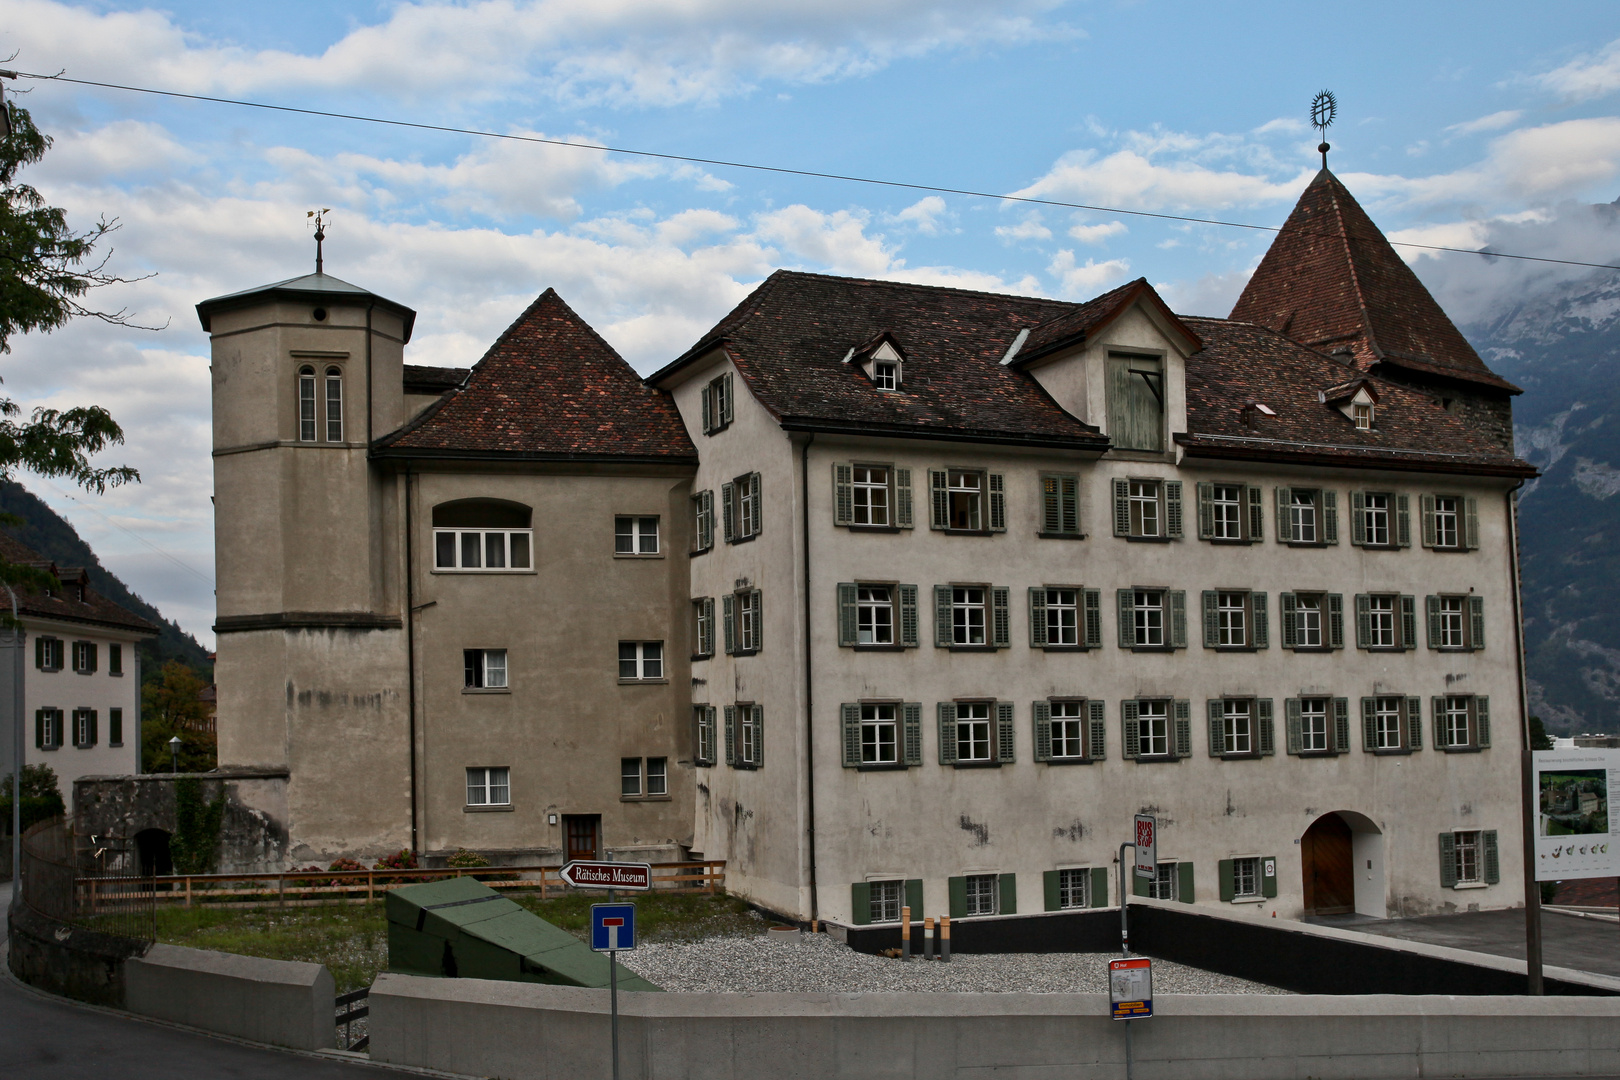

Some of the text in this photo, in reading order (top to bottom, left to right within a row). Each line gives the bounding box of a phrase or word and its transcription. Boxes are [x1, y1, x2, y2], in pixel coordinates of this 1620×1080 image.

[1137, 820, 1152, 836] BUS
[1137, 834, 1152, 848] STOP
[575, 866, 646, 883] Rätisches Museum
